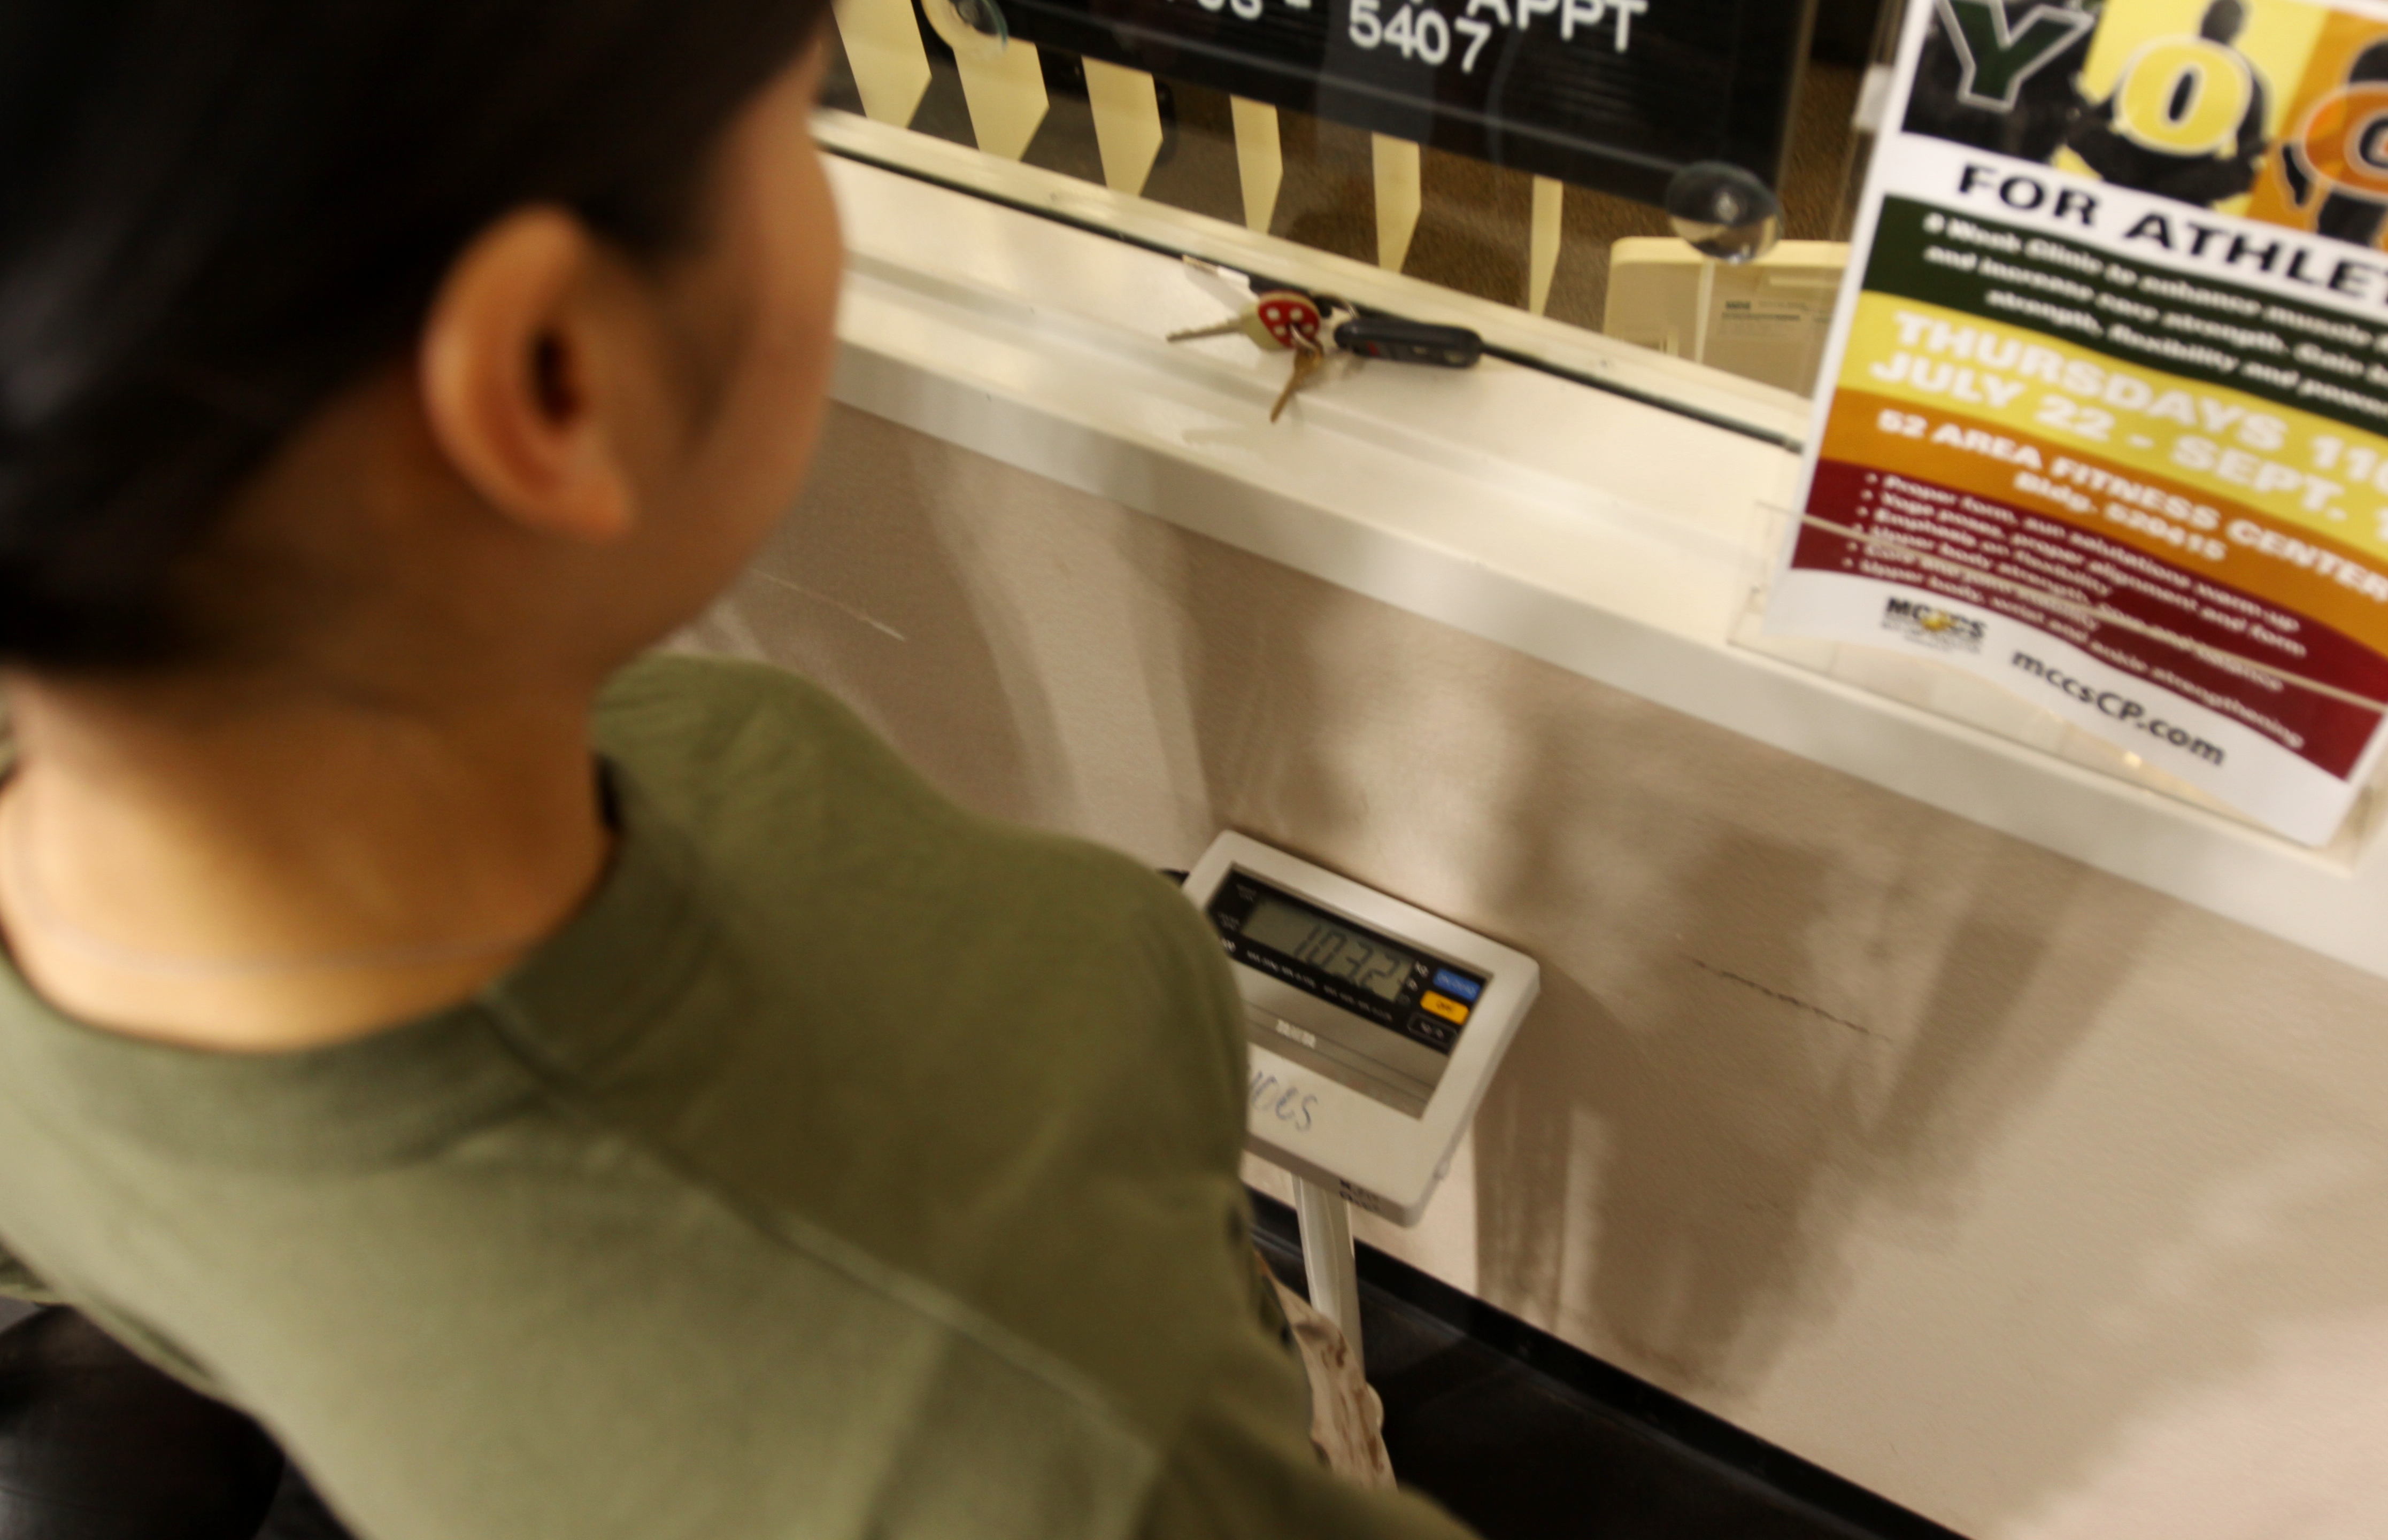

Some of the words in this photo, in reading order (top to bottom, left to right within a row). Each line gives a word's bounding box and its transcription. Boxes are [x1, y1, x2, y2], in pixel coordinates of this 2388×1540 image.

[1959, 162, 2099, 226] FOR
[2123, 213, 2388, 307] ATHLE
[2024, 238, 2104, 276] Clinic
[2104, 263, 2137, 288] to
[2138, 275, 2262, 317] enhance
[2262, 305, 2374, 347] muscle
[1924, 245, 1978, 272] and
[1979, 256, 2094, 303] increase
[2095, 291, 2159, 323] core
[2292, 341, 2366, 378] Gain
[2106, 322, 2240, 373] flexibility
[2241, 361, 2300, 389] and
[1870, 351, 2027, 408] JULY
[2037, 393, 2116, 442] 22
[2170, 435, 2348, 522] SEPT.
[1895, 310, 2289, 451] THURSDAYS
[1877, 409, 1928, 439] 52
[1931, 422, 2043, 469] AREA
[2051, 456, 2222, 531] FITNESS
[1882, 474, 1958, 506] Proper
[2069, 531, 2191, 588] salutations
[2014, 471, 2098, 514] Bldg.
[1873, 507, 1977, 548] Emphasis
[1979, 539, 2011, 558] on
[2013, 548, 2114, 597] flexibility
[1881, 490, 1935, 516] Yoga
[2009, 532, 2085, 566] proper
[2089, 559, 2198, 612] alignment
[2199, 606, 2248, 634] and
[2249, 622, 2307, 658] form
[2010, 649, 2225, 766] mccsCP.com
[2046, 617, 2088, 642] and
[2150, 666, 2305, 749] strengthening
